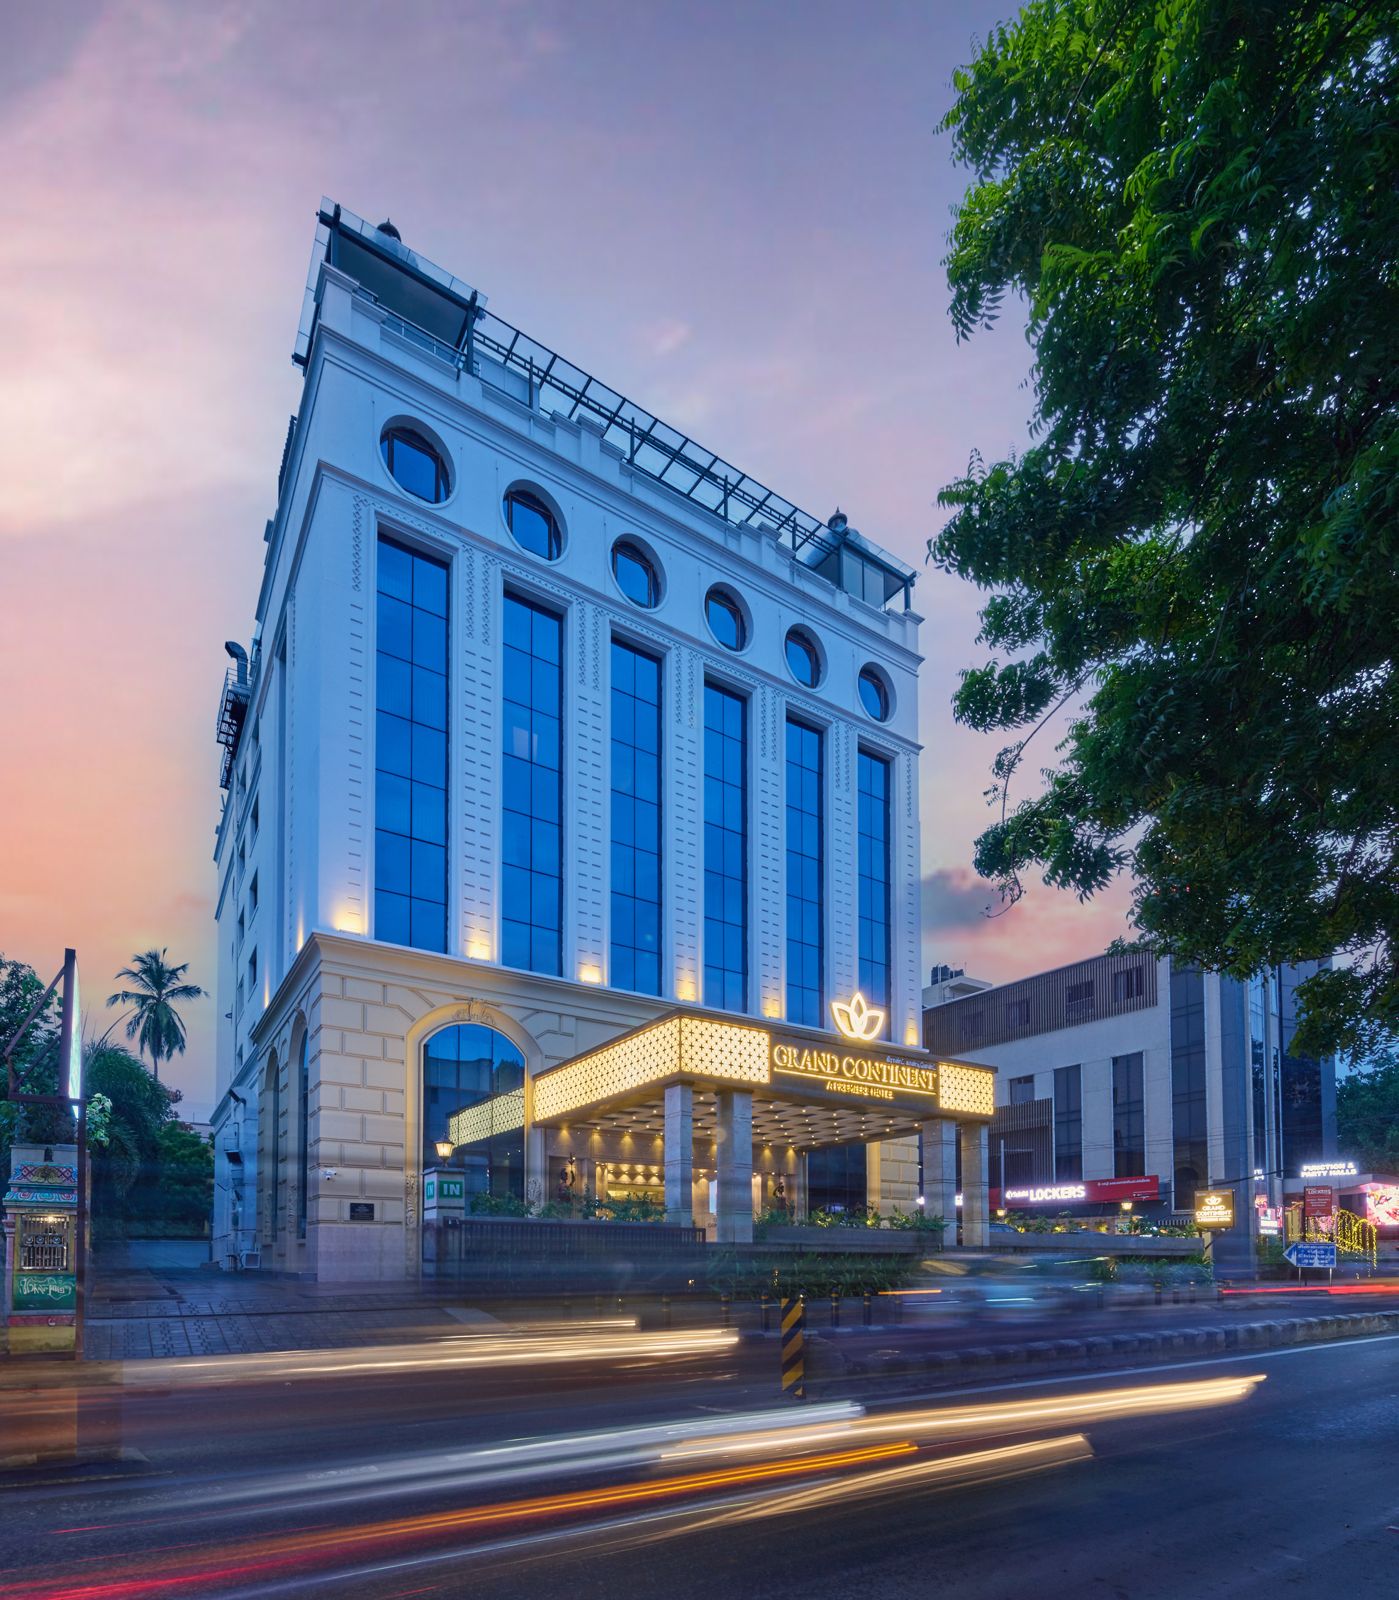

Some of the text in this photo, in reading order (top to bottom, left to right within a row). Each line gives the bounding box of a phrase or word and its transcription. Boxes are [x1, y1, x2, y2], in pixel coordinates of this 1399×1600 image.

[773, 1044, 839, 1074] GRAND
[842, 1057, 937, 1090] CONTINENT
[427, 1183, 434, 1196] IN
[443, 1183, 460, 1195] IN
[1029, 1185, 1086, 1201] LOCKERS
